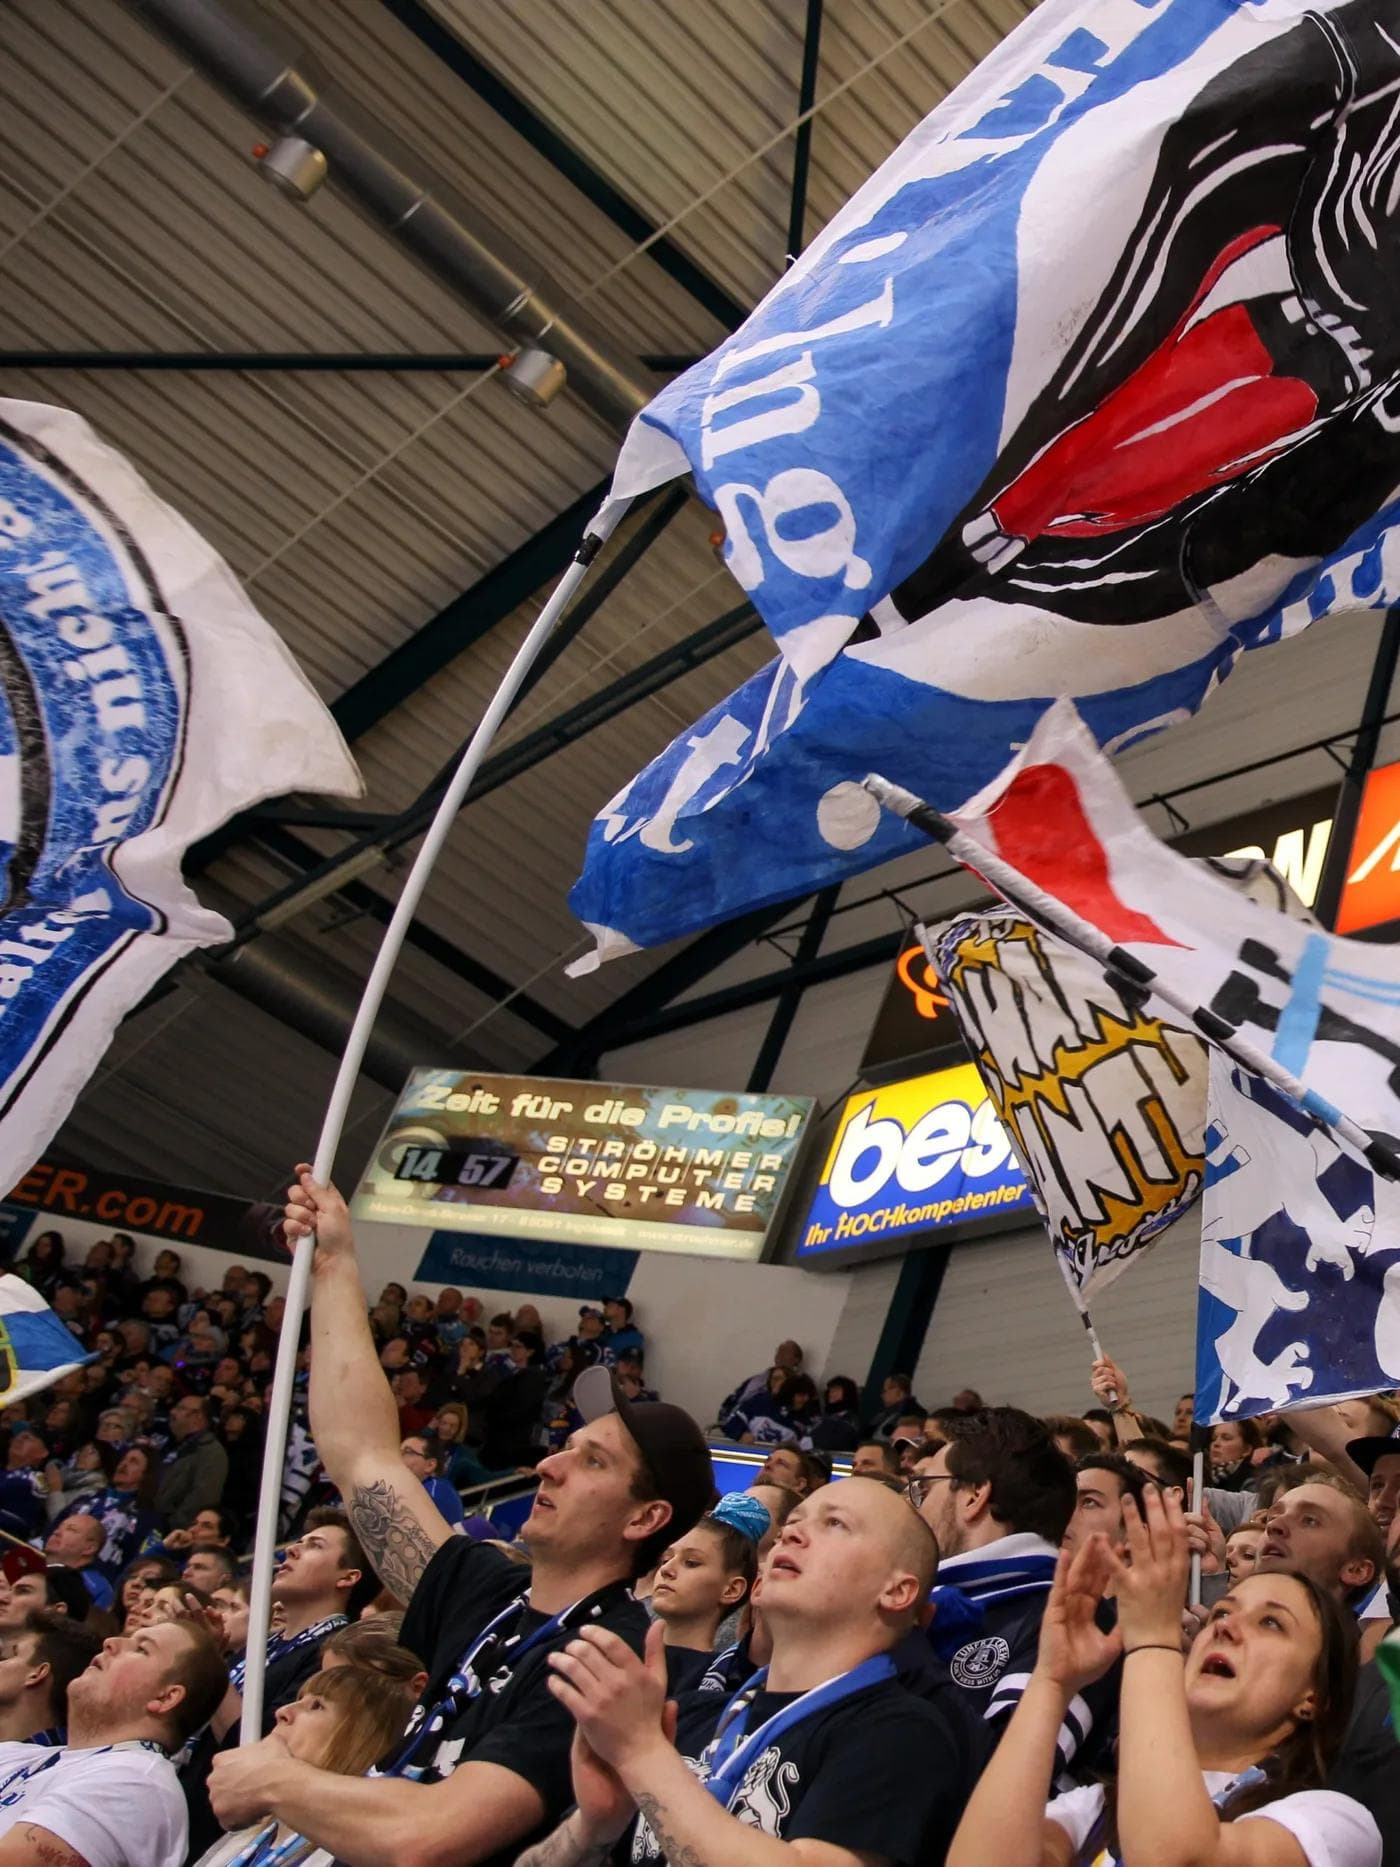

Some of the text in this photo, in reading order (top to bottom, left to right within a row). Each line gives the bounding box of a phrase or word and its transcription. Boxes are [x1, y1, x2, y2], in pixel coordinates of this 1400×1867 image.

[25, 550, 147, 730] nicht
[416, 1084, 801, 1138] Zeit für die Profis!
[400, 1149, 511, 1187] 14 57
[537, 1155, 776, 1192] COMPUTER
[829, 1101, 1020, 1208] bes
[540, 1176, 756, 1212] SYSTEME
[804, 1183, 1027, 1247] Ihr HOCHkompetenter
[450, 1249, 603, 1281] Rauchen verboten
